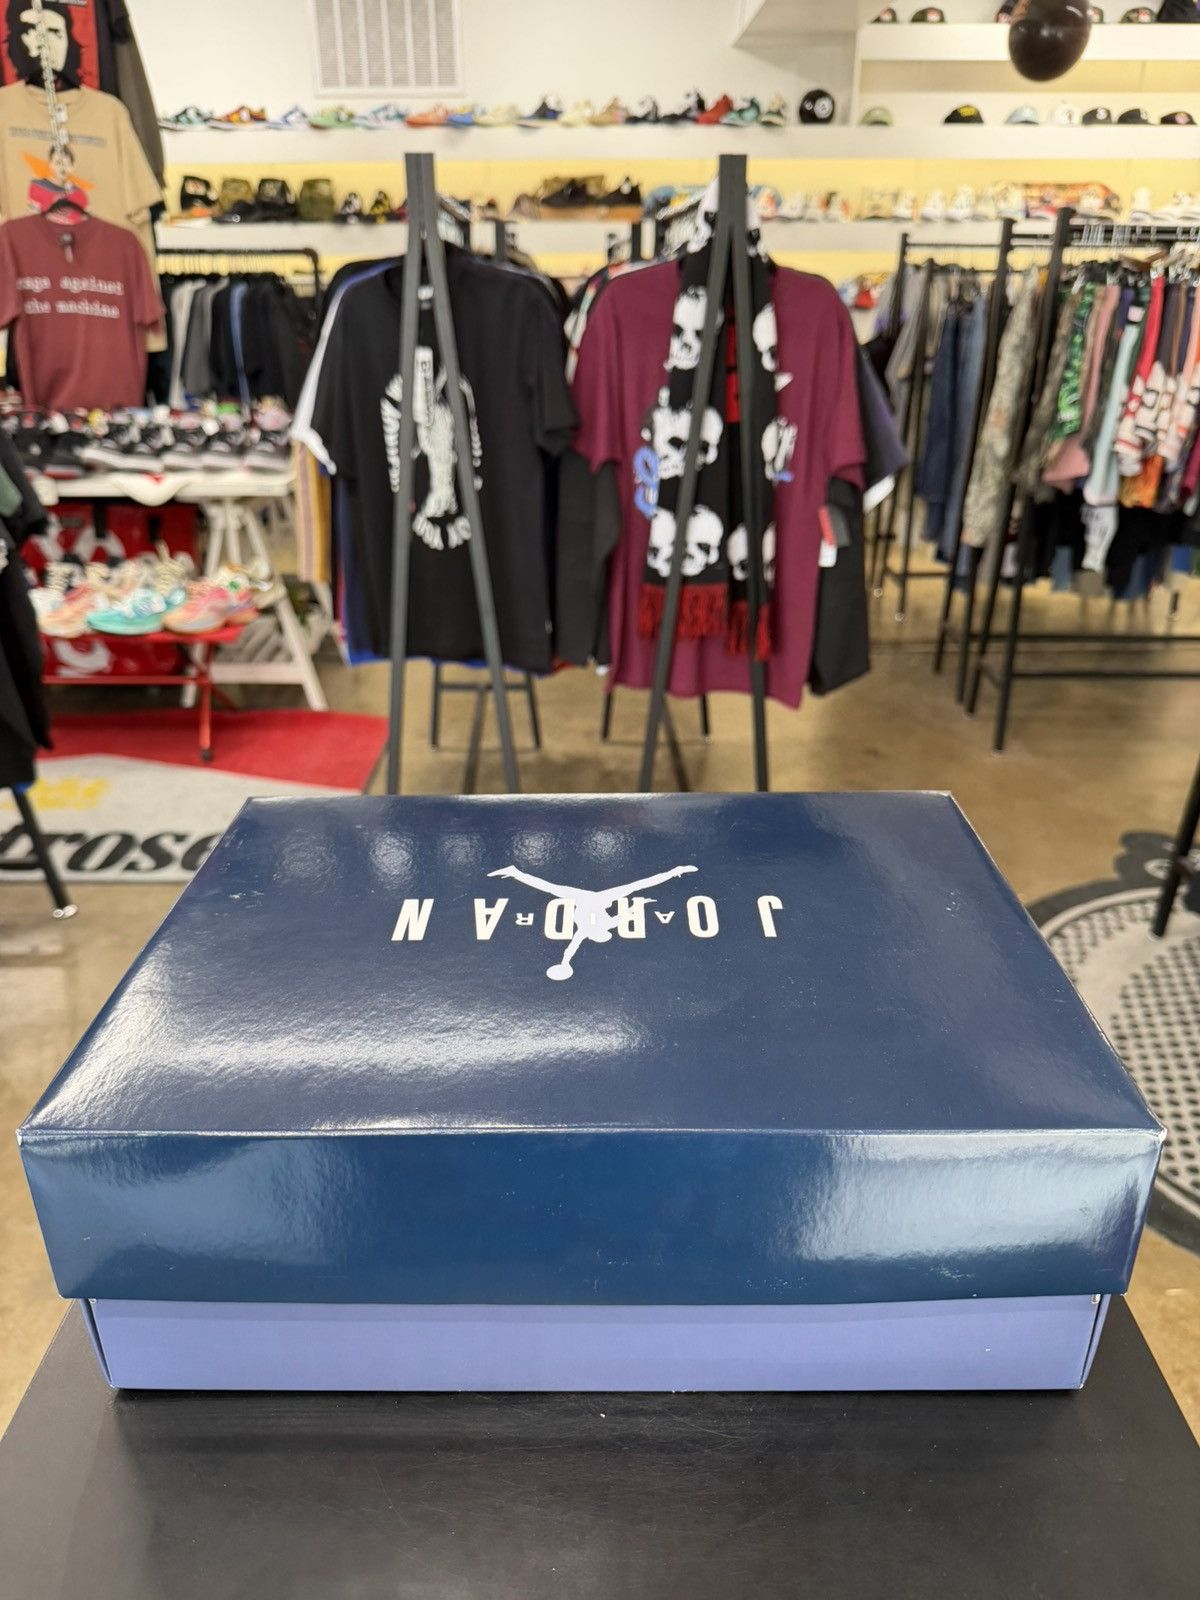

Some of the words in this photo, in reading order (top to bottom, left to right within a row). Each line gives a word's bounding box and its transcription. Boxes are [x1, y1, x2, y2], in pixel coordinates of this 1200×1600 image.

[59, 276, 124, 296] against
[24, 298, 51, 314] the
[55, 299, 120, 319] machine
[391, 895, 784, 941] JORDAN
